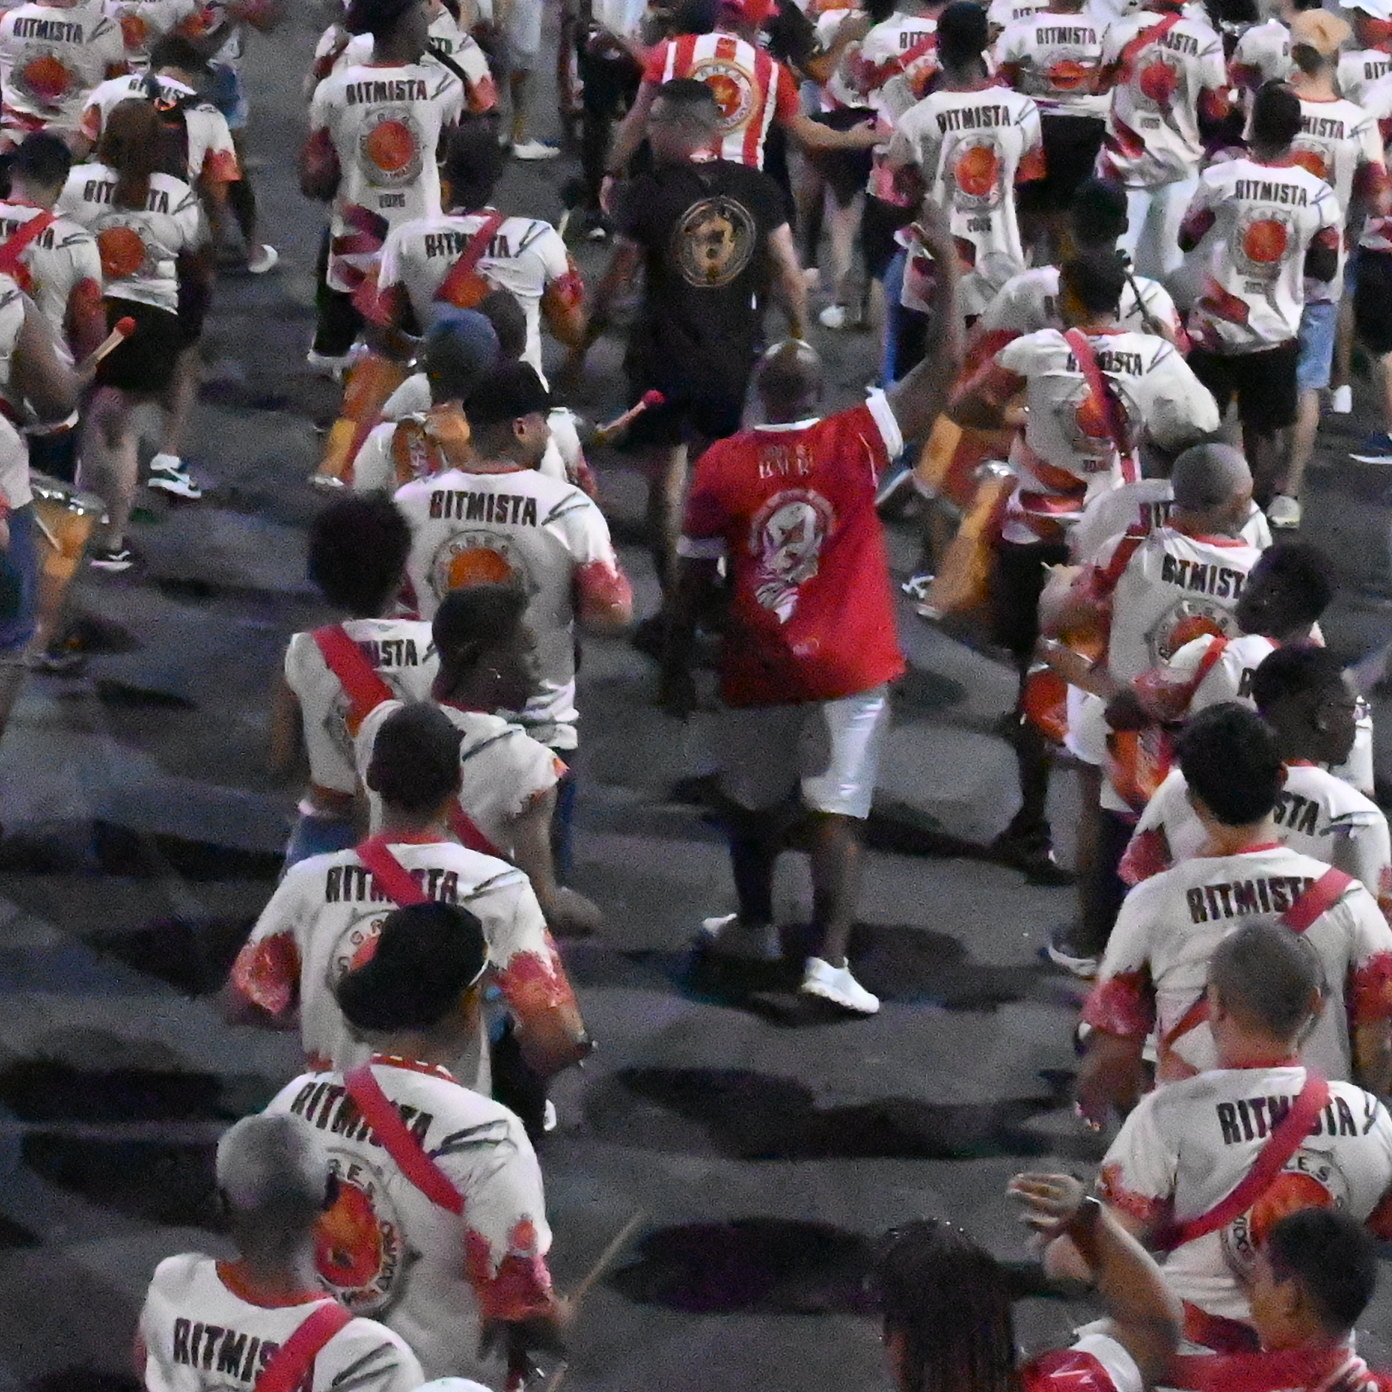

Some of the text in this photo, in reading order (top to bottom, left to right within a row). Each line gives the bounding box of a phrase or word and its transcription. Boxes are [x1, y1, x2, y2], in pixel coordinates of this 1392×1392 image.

[12, 17, 84, 45] RITMISTA
[1036, 27, 1096, 46] RITMISTA
[345, 79, 427, 105] RITMISTA
[936, 105, 1010, 133] RITMISTA
[1235, 180, 1306, 206] RITMISTA
[429, 491, 537, 526] RITMISTA
